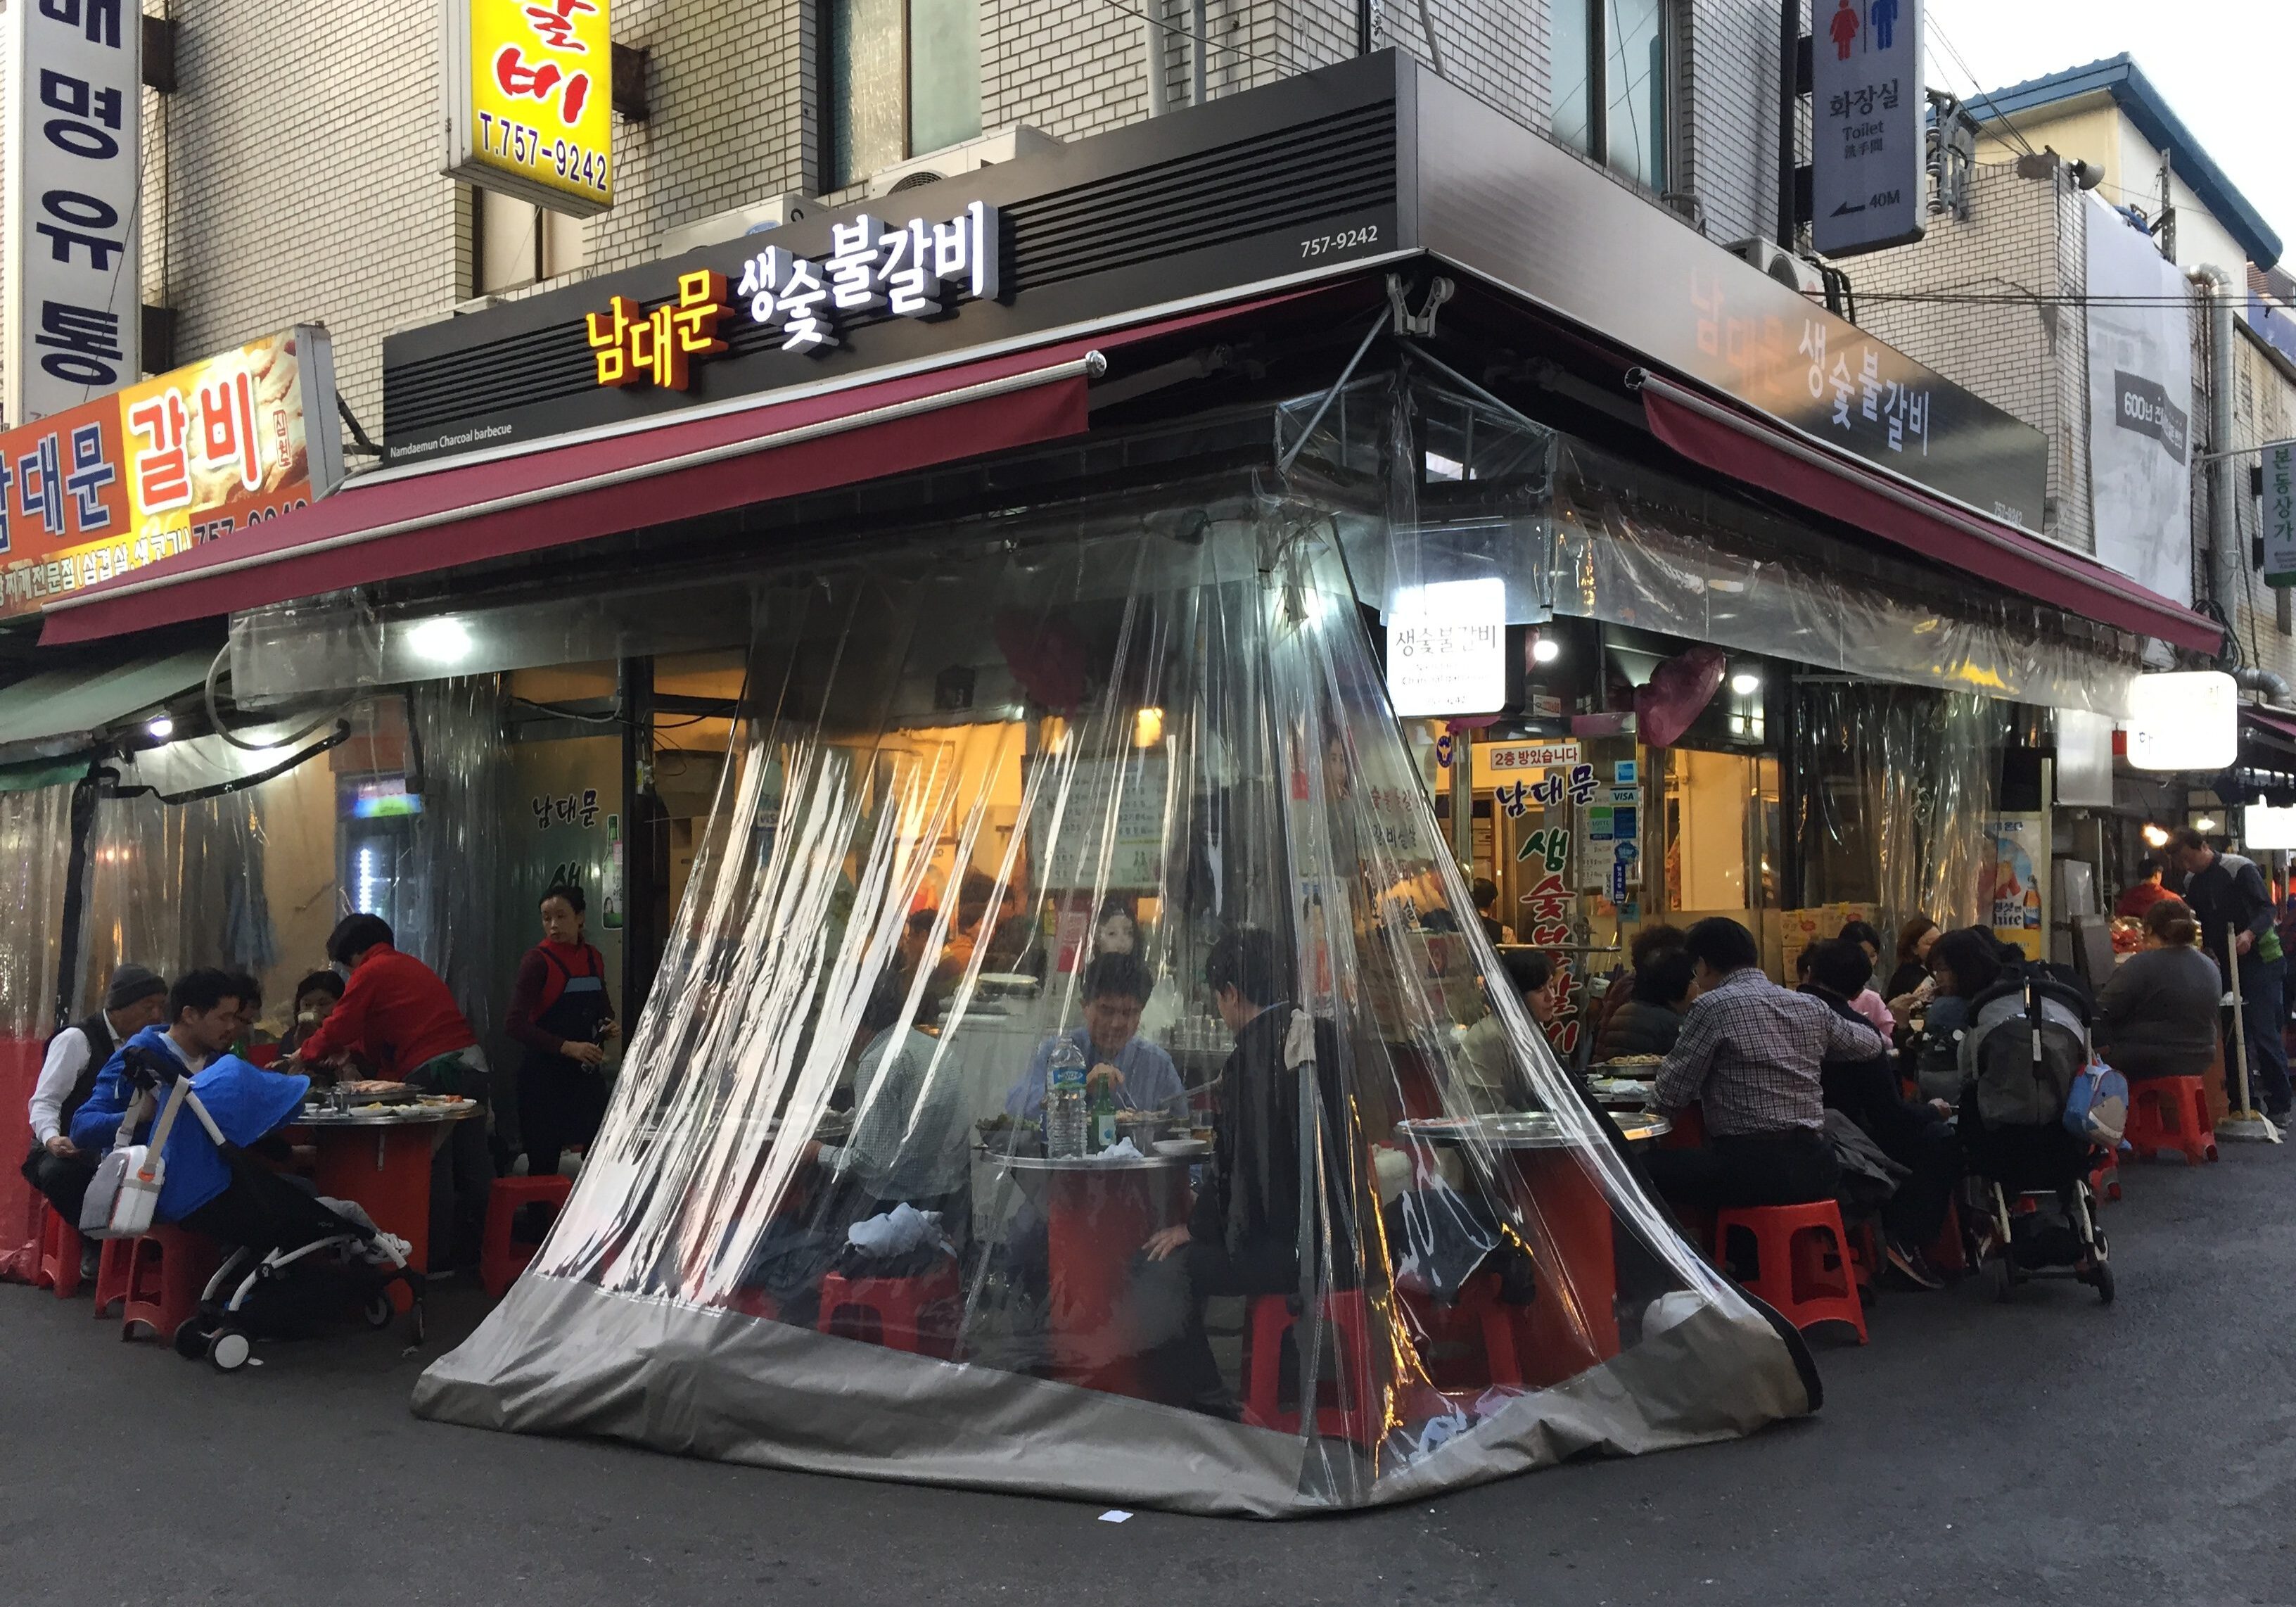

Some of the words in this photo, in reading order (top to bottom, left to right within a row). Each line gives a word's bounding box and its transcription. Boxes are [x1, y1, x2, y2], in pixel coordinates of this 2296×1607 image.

[1830, 78, 1899, 118] 화장실
[1842, 120, 1884, 141] Toilet
[480, 112, 607, 191] T.757-9242
[1870, 189, 1900, 208] 40M
[1300, 225, 1379, 258] 757-9242
[587, 269, 718, 387] 남대문
[737, 201, 986, 351] 생숯불갈비
[1690, 270, 1787, 402] 남대문
[1799, 318, 1929, 457] 생숯불갈비
[129, 367, 262, 514] 갈비
[390, 440, 438, 458] Namdaemun
[440, 430, 473, 448] Charcoal
[474, 424, 512, 440] barbecue
[1495, 751, 1515, 767] 2층
[1518, 747, 1578, 766] 방있습니다
[532, 789, 599, 830] 남대문
[1495, 764, 1600, 818] 남대문
[1614, 792, 1634, 801] VISA
